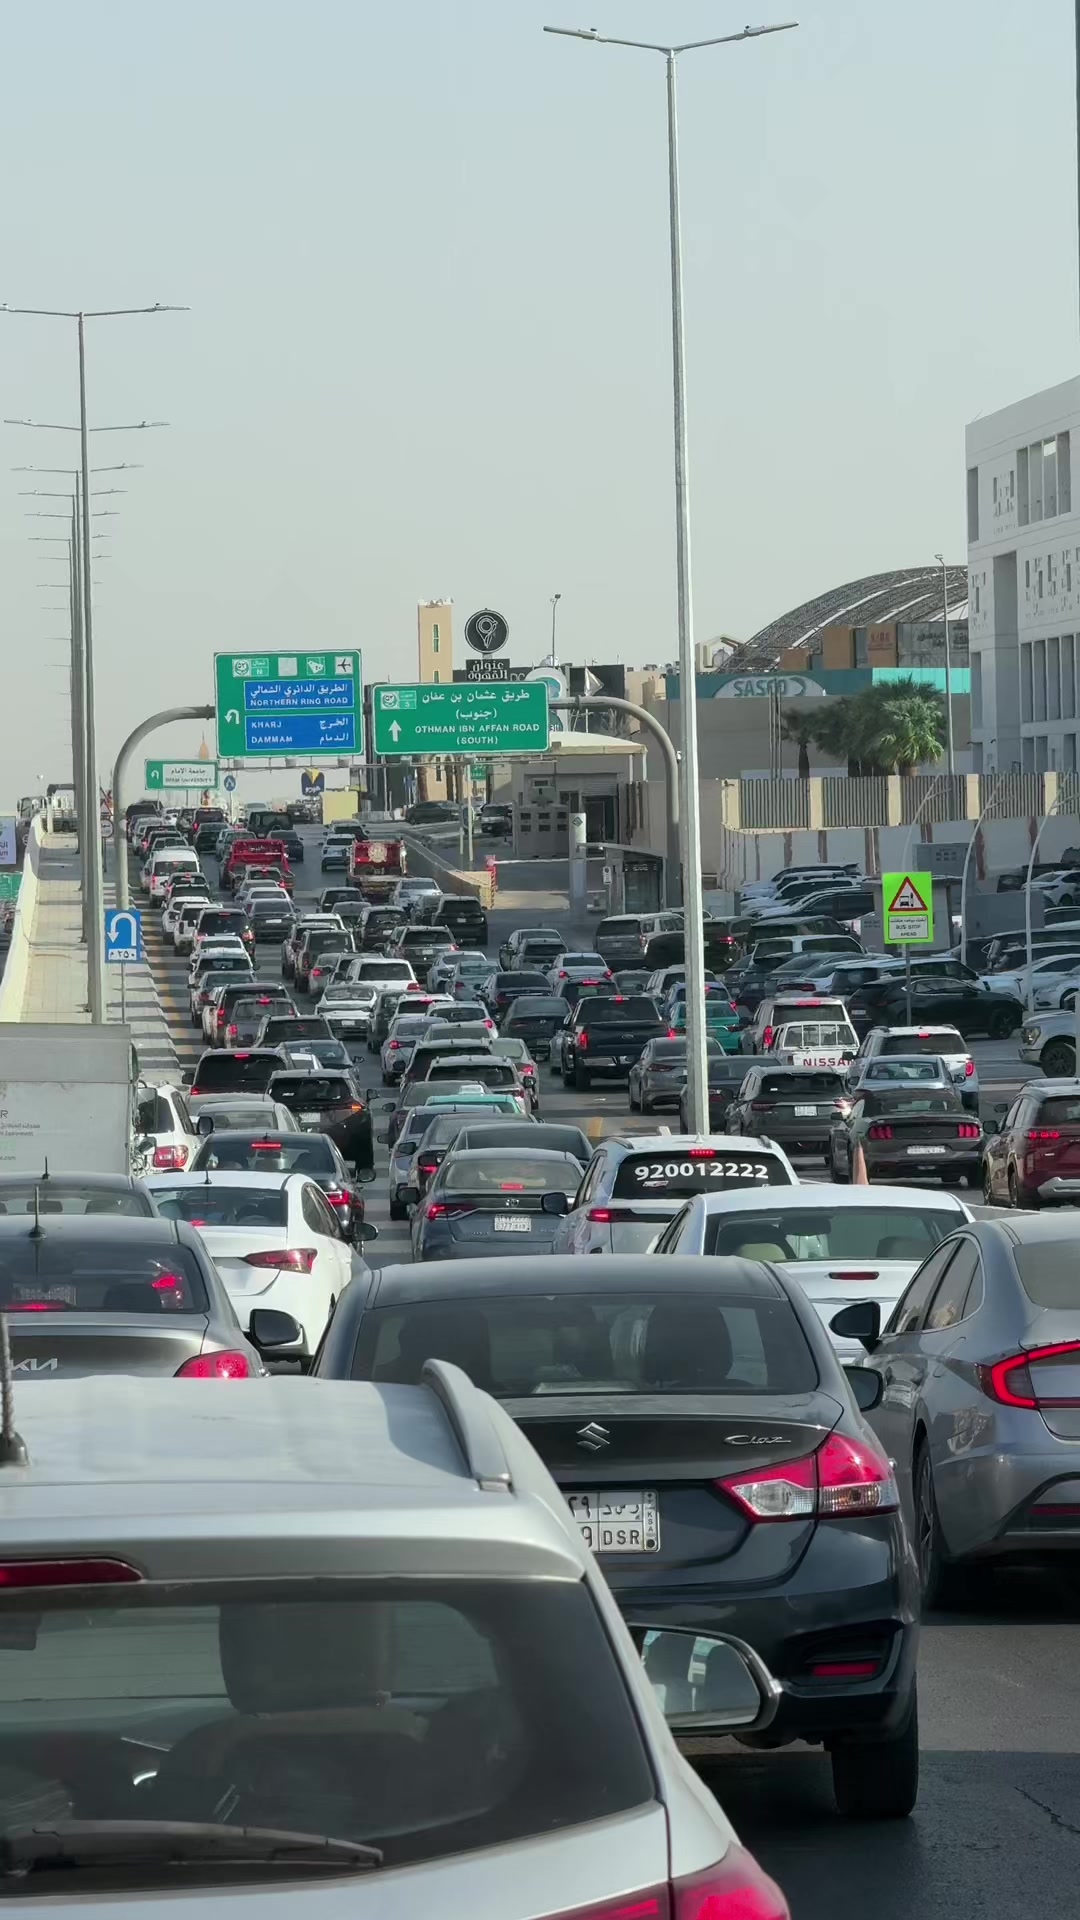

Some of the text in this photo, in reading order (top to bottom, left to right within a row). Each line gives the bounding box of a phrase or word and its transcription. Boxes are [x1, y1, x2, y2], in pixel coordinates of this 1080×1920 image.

[472, 660, 504, 672] عنوان
[467, 670, 508, 682] القهوة
[250, 684, 348, 699] الطريق الدائري الشمالي
[422, 689, 530, 704] طريق عثمان بن عفان
[250, 698, 297, 706] NORTHERN
[301, 697, 321, 705] RING
[251, 721, 282, 729] KHARJ
[319, 718, 349, 729] الخرج
[415, 725, 455, 734] OTHMAN
[459, 725, 475, 733] IBN
[479, 724, 509, 732] AFFAN
[512, 723, 540, 732] ROAD
[251, 735, 293, 744] DAMMAM
[319, 732, 349, 745] الدمام
[456, 735, 498, 745] (SOUTH)
[634, 1162, 769, 1181] 920012222
[603, 1529, 640, 1546] DSR
